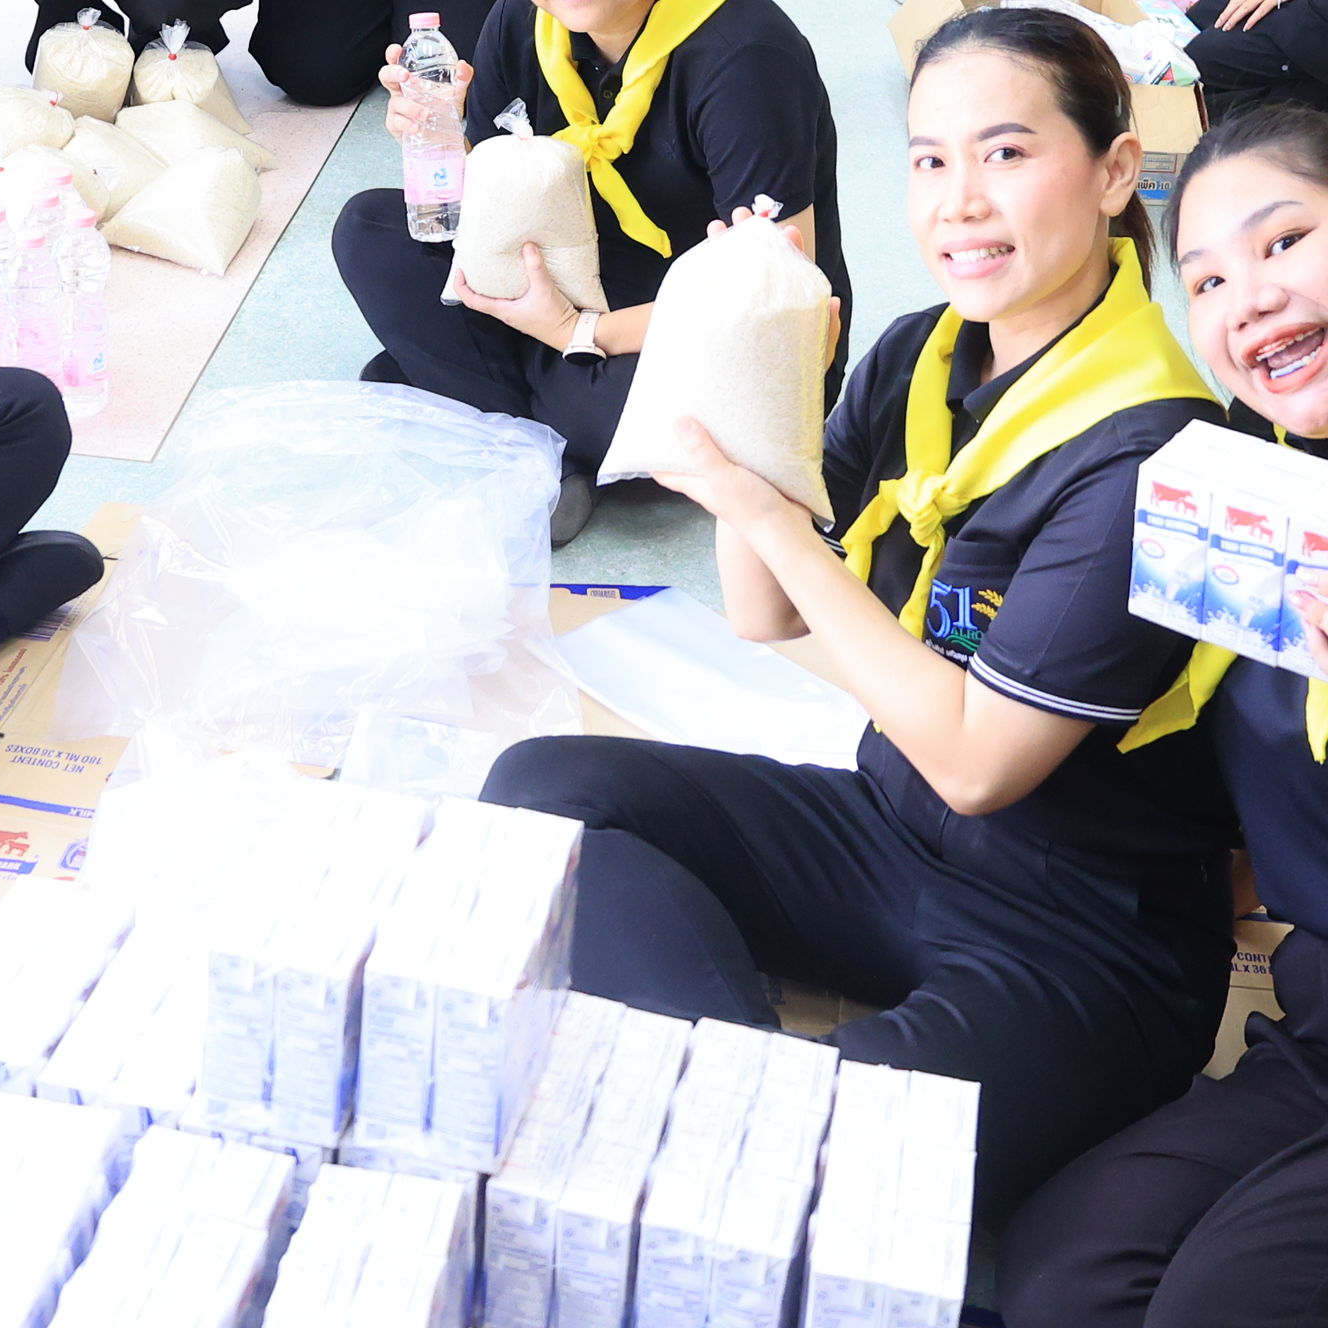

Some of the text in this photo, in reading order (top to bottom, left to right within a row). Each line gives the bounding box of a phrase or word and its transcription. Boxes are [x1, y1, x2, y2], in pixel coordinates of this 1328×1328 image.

[926, 578, 978, 638] 51
[5, 744, 40, 756] BOXES
[41, 749, 55, 758] 36
[65, 751, 82, 762] ML
[84, 755, 103, 766] 180
[10, 755, 85, 773] NET CONTENT
[1236, 951, 1271, 963] CONT
